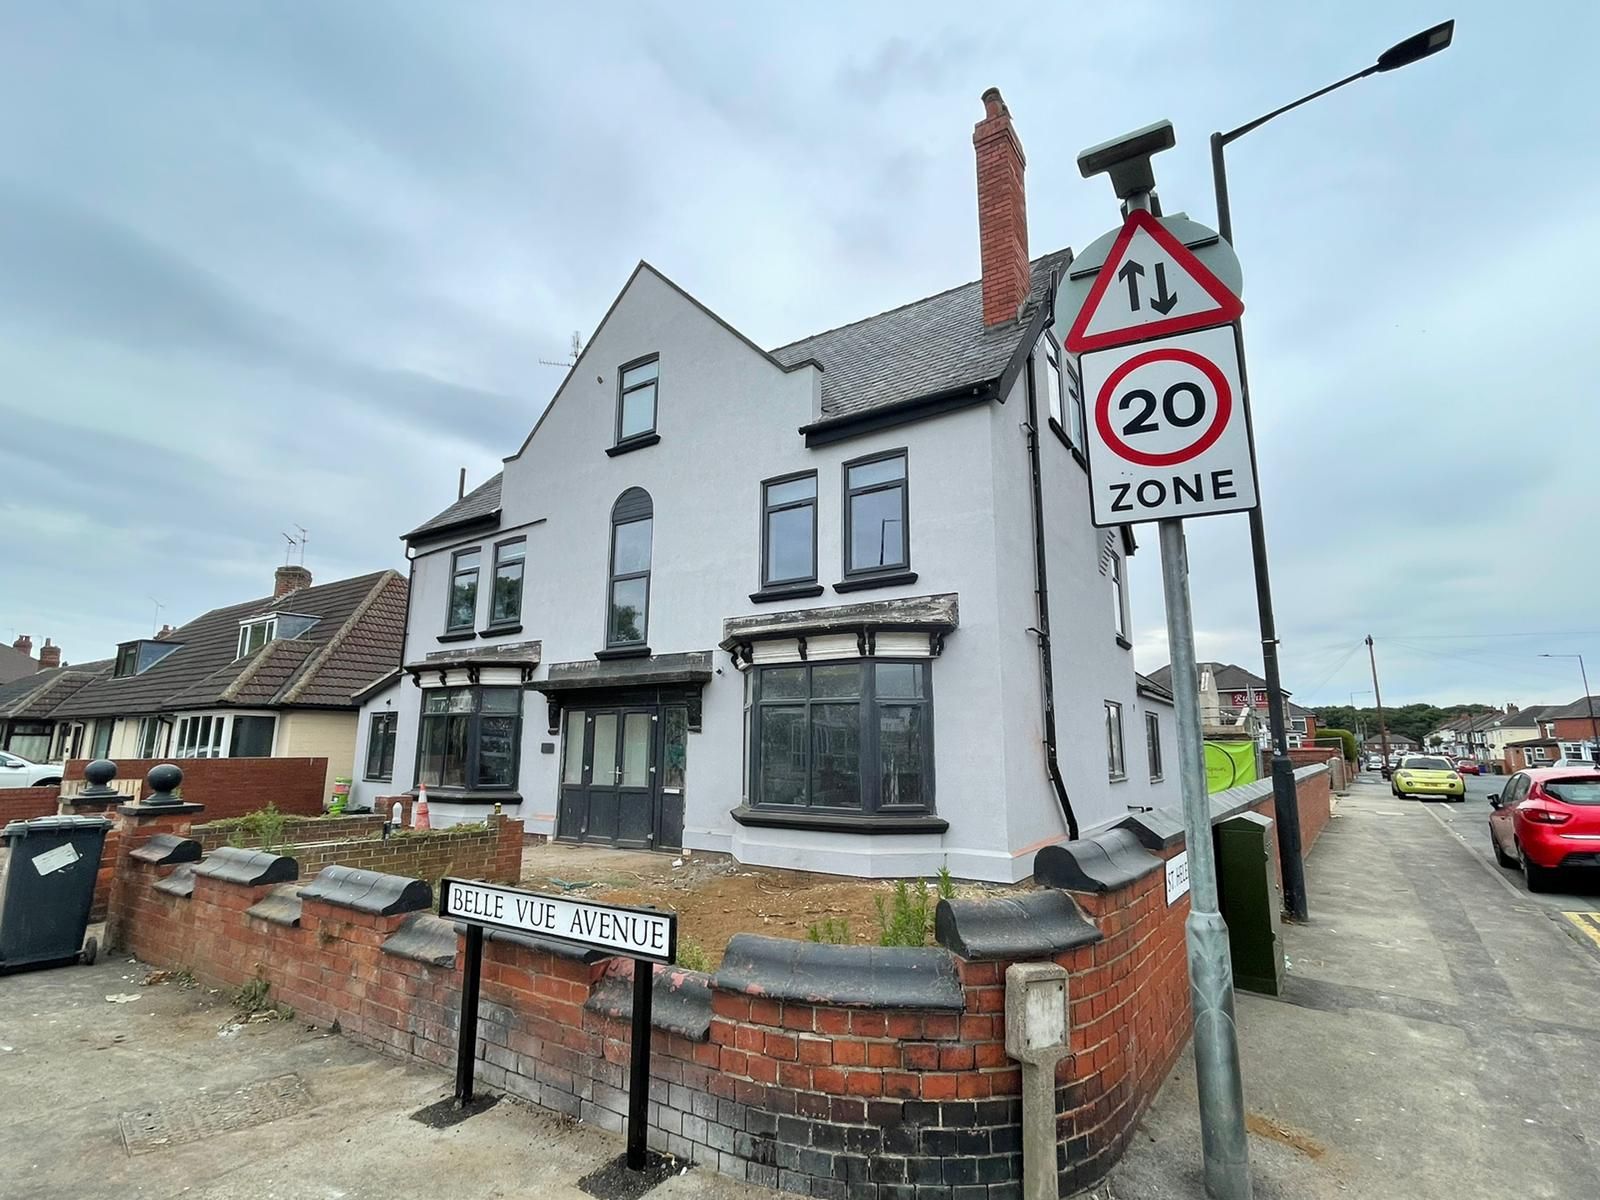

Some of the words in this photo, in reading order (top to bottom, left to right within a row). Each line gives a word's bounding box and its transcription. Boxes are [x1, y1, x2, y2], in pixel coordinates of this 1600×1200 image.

[1118, 381, 1206, 437] 20
[1109, 469, 1237, 512] ZONE
[452, 887, 504, 920] BELLE
[516, 898, 556, 930] VUE
[570, 907, 664, 950] AVENUE
